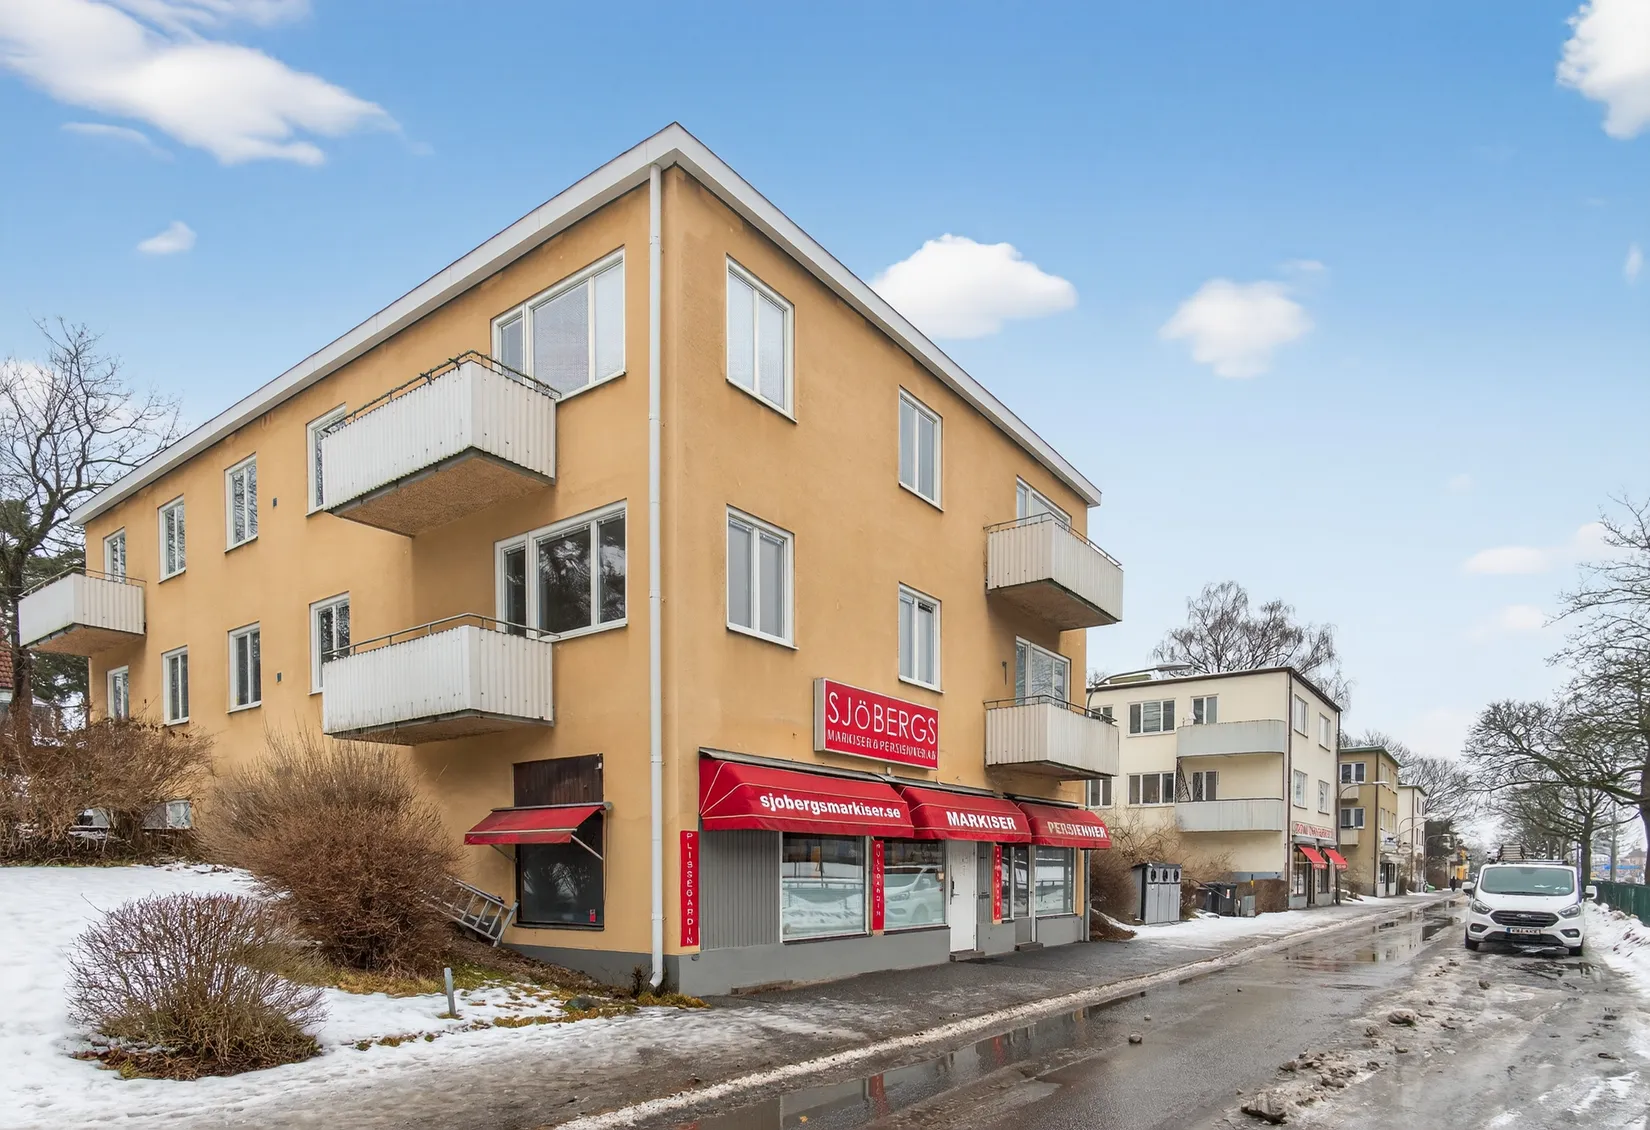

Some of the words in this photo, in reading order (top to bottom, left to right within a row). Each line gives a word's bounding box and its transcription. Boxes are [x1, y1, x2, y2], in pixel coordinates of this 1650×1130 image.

[828, 691, 936, 745] SJÖBERGS
[760, 793, 900, 818] sjobergsmarkiser.se
[946, 811, 1017, 830] MARKISER
[1047, 821, 1107, 839] PERSIENNER
